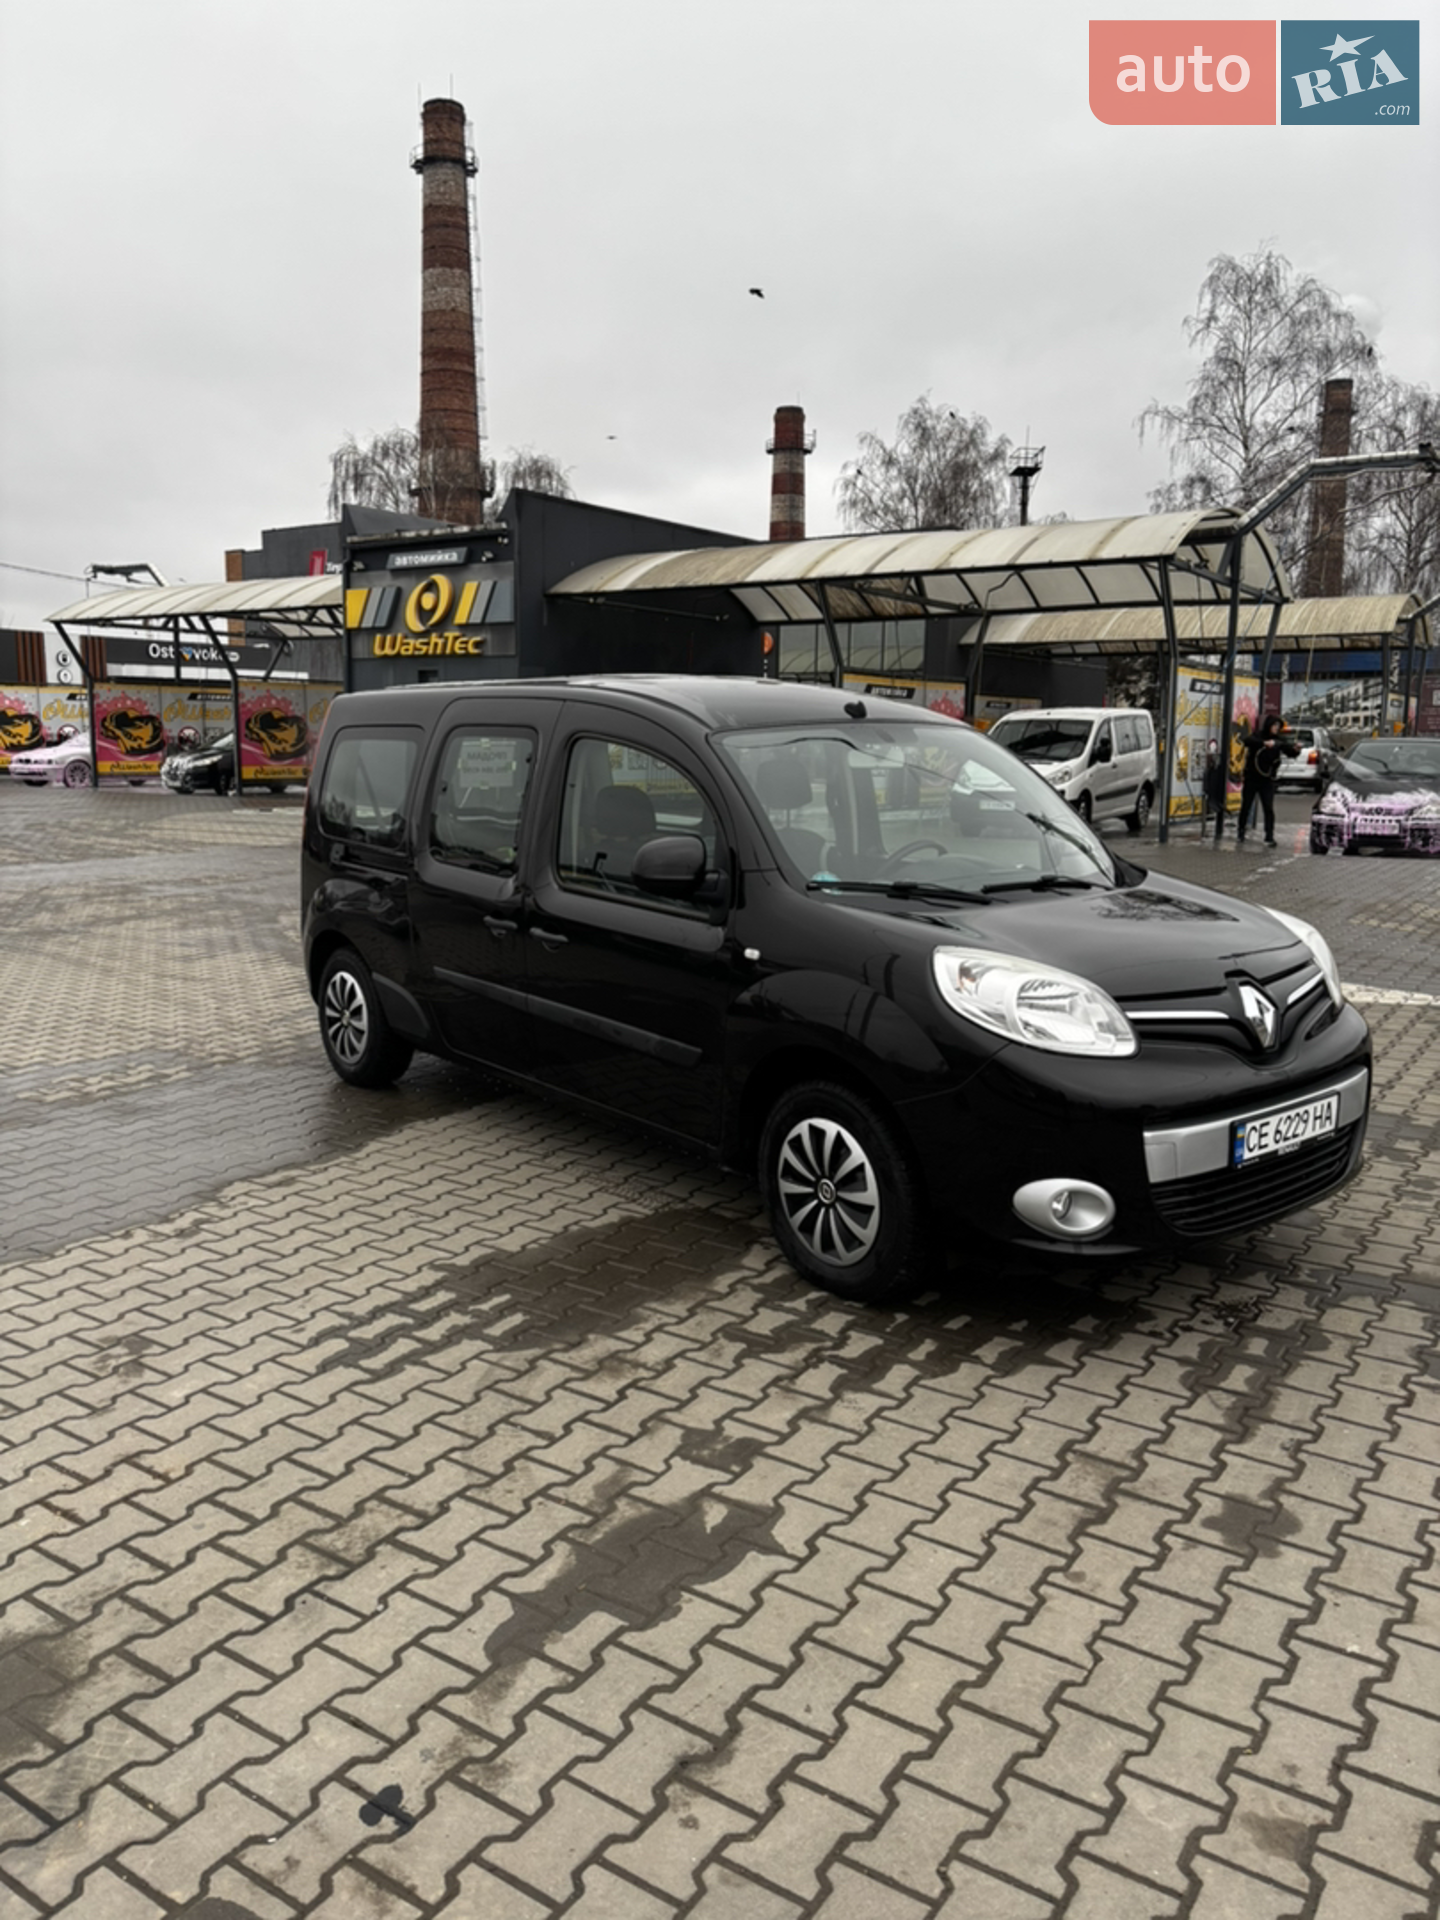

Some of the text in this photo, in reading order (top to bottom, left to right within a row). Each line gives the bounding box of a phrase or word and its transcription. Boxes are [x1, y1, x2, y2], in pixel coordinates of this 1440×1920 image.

[373, 632, 484, 656] WashTec
[1246, 1121, 1270, 1153] CE
[1273, 1109, 1310, 1145] 6229
[1311, 1101, 1333, 1132] HA
